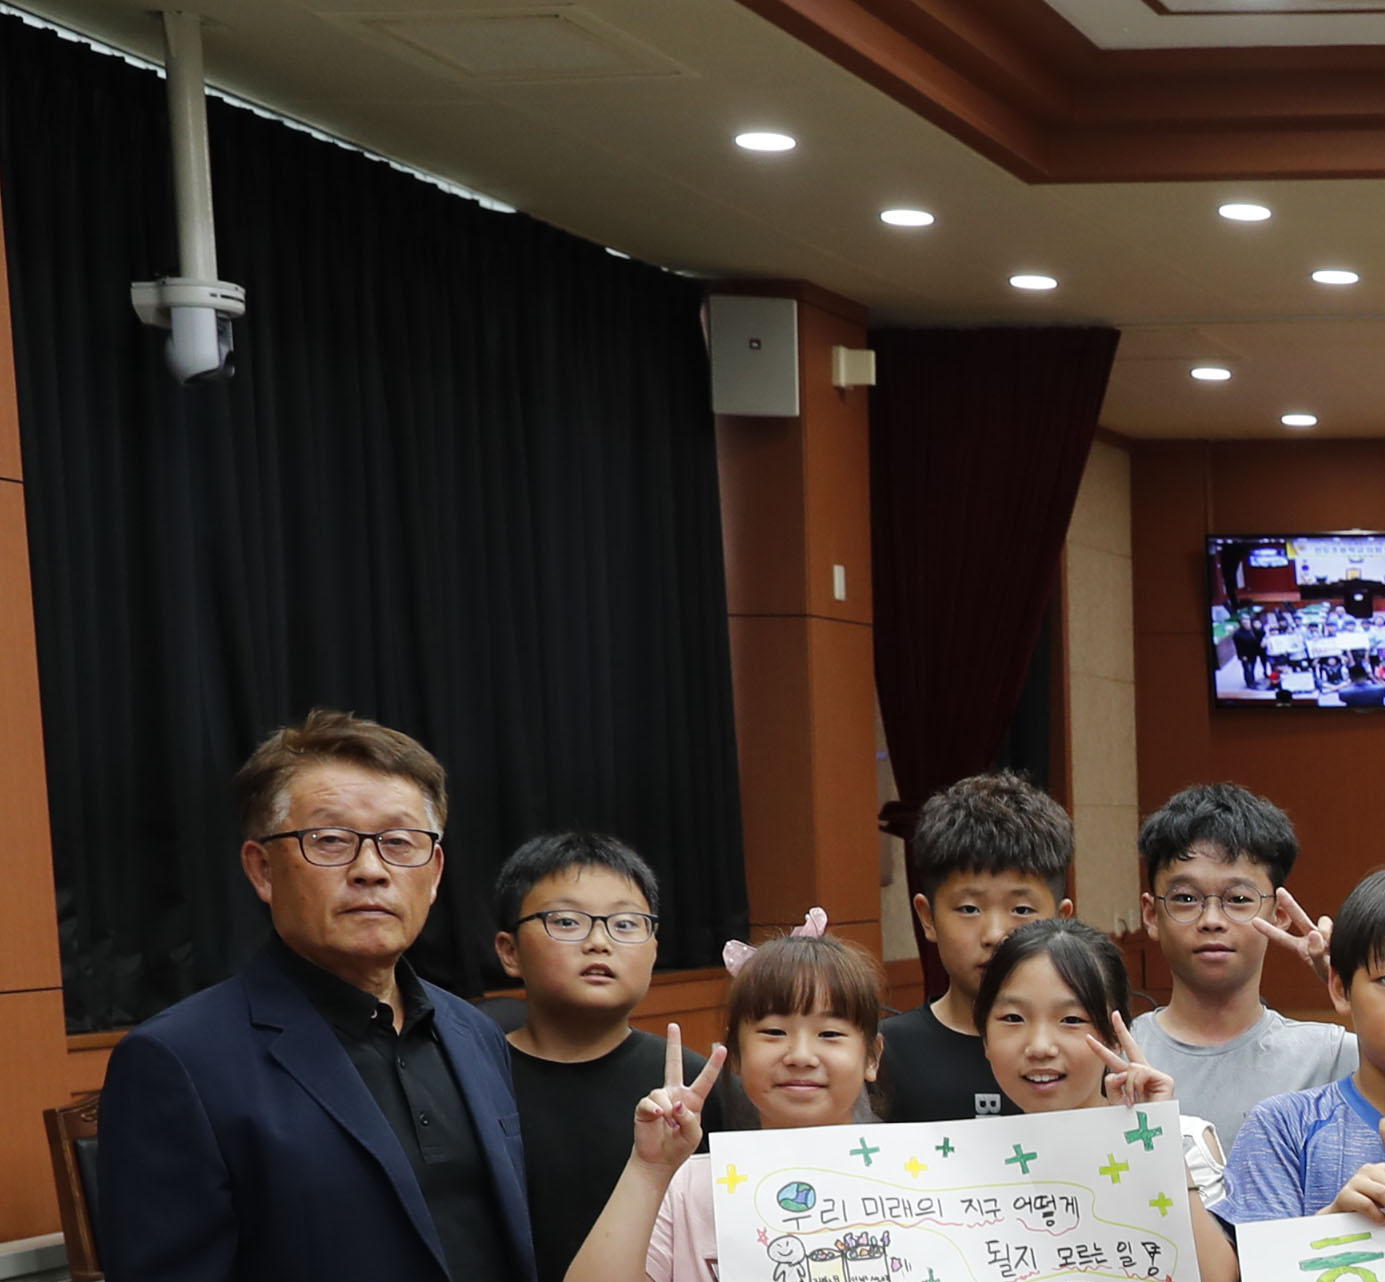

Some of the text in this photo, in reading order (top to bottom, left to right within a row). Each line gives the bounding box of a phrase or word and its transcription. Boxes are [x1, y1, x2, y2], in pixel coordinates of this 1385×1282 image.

[862, 1197, 944, 1219] 미래의
[961, 1196, 1004, 1220] 지구
[1013, 1193, 1081, 1227] 어떻게
[985, 1240, 1038, 1279] 될지
[1056, 1245, 1107, 1269] 모르는
